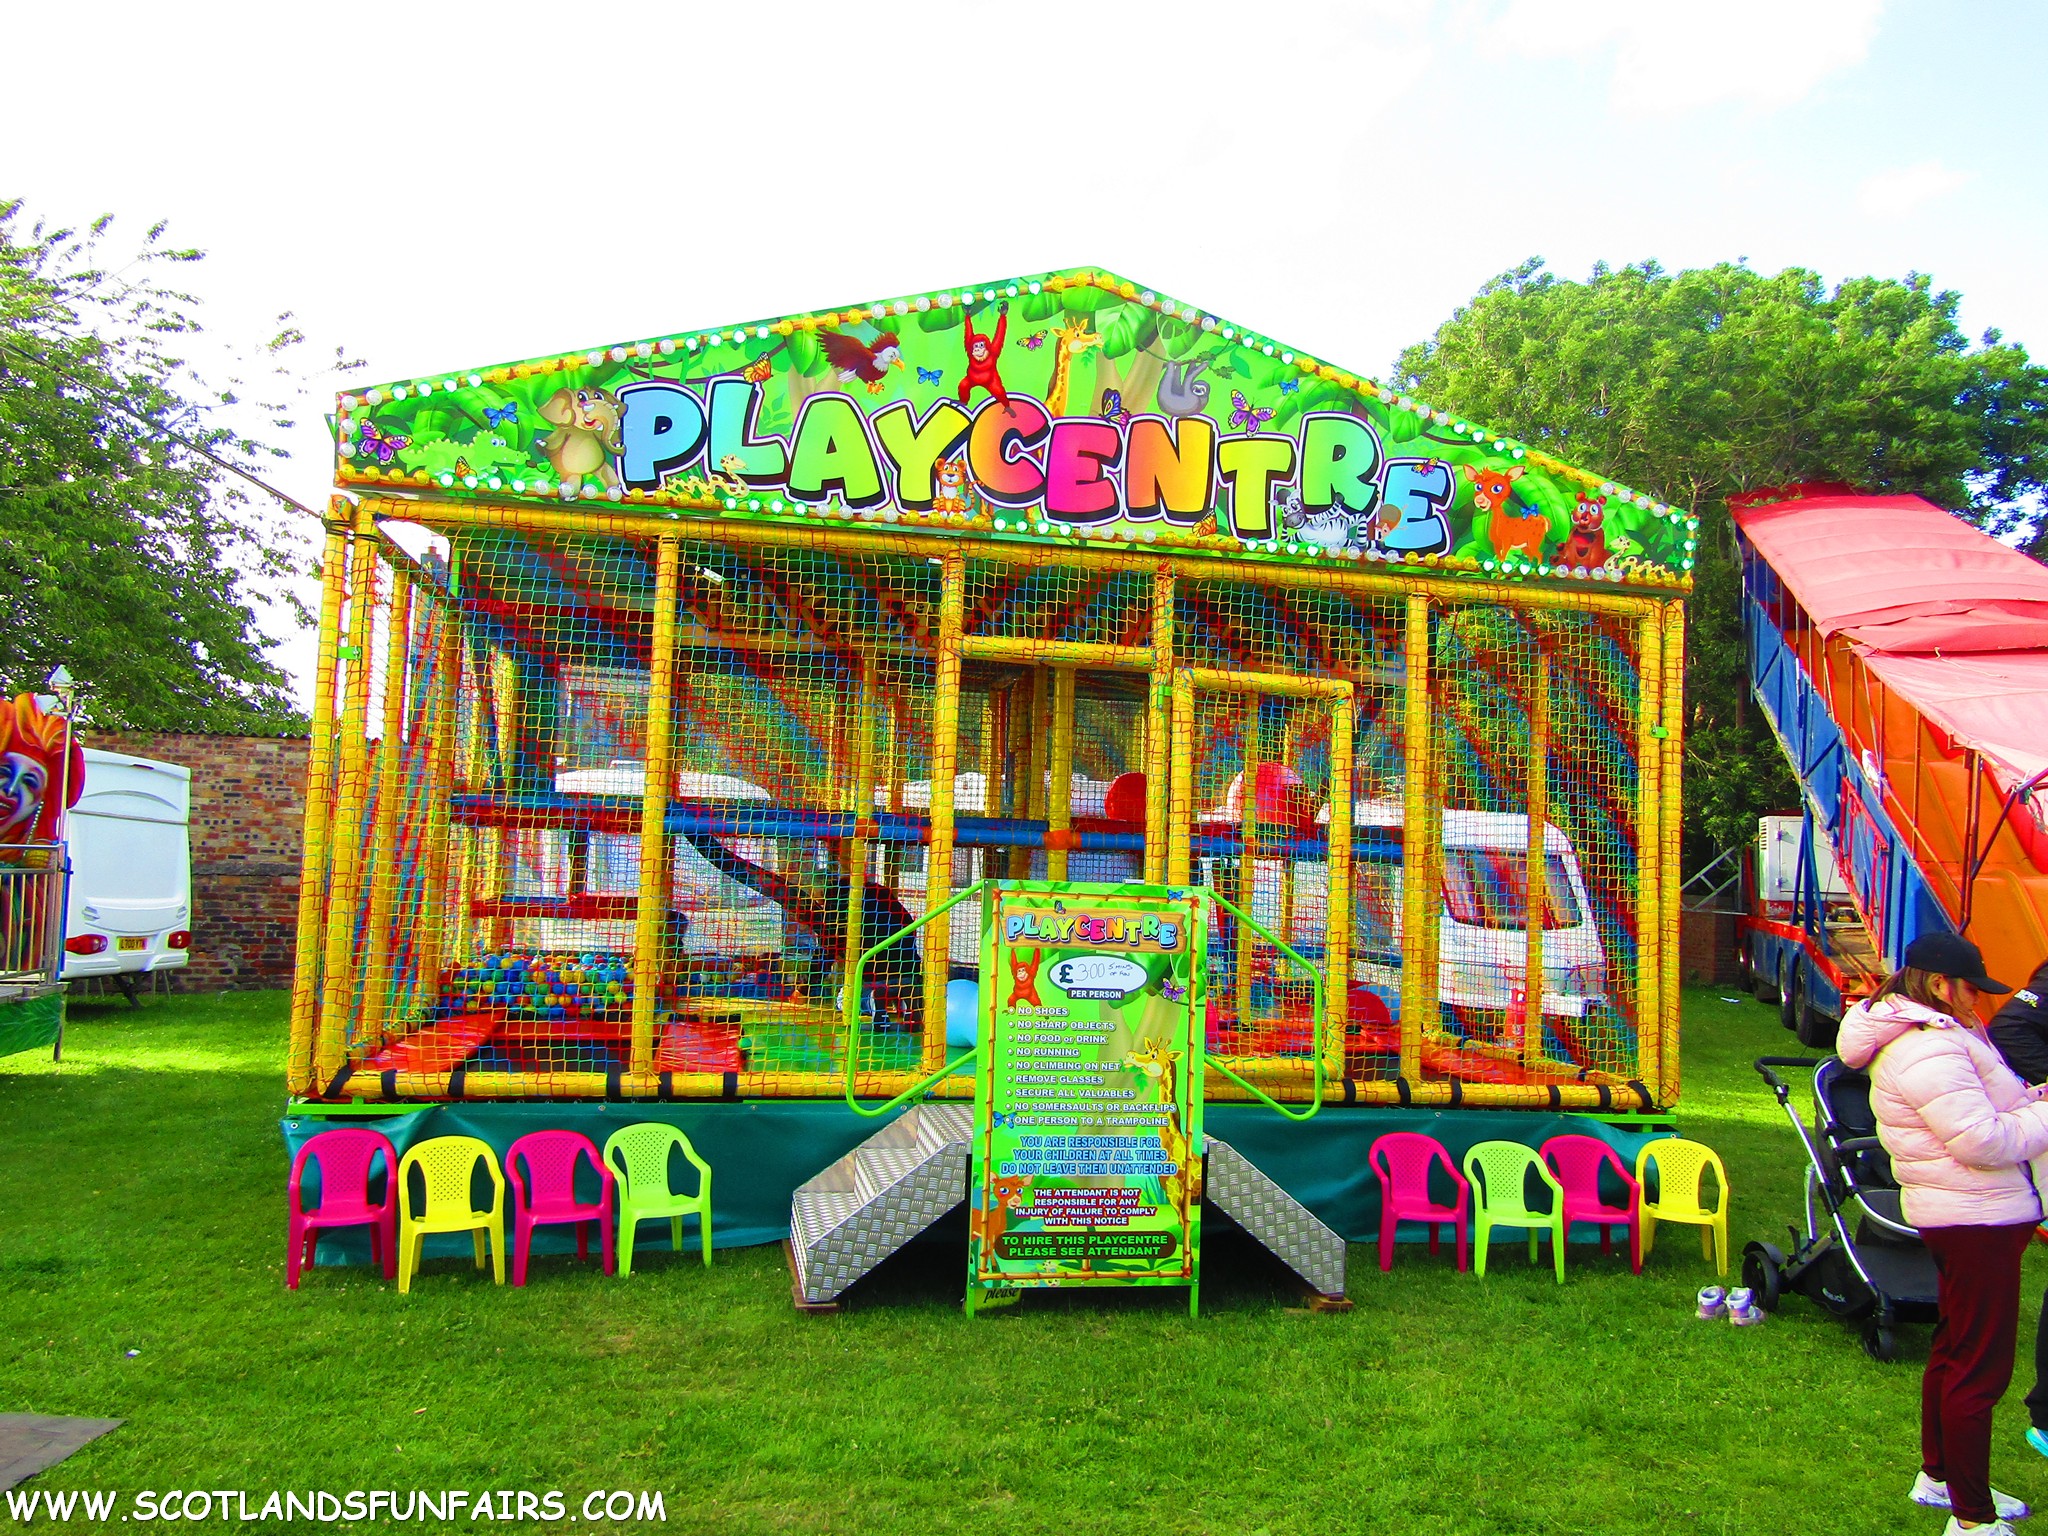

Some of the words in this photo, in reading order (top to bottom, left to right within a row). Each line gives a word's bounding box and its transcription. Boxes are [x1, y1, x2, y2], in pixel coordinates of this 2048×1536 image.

[620, 373, 1453, 558] PLAYCENTRE
[1006, 913, 1178, 948] PLAYCENTRE
[1071, 989, 1087, 998] PER
[1089, 990, 1122, 998] PERSON
[1018, 1007, 1033, 1015] NO
[1035, 1007, 1068, 1016] SHOES
[1017, 1020, 1032, 1029] NO
[1034, 1021, 1067, 1029] SHARP
[1070, 1022, 1116, 1030] OBJECTS
[1017, 1034, 1032, 1042] NO
[1076, 1035, 1107, 1043] DRINK
[1016, 1048, 1031, 1056] NO
[1034, 1048, 1079, 1056] RUNNING
[1033, 1062, 1081, 1070] CLIMBING
[1101, 1063, 1121, 1071] NET
[1016, 1075, 1057, 1083] REMOVE
[1060, 1076, 1103, 1084] GLASSES
[1058, 1089, 1075, 1097] ALL
[1078, 1090, 1135, 1098] VALUABLES
[1032, 1103, 1103, 1111] SOMERSAULTS
[1123, 1104, 1176, 1112] BACKFLIPS
[1014, 1117, 1035, 1125] ONE
[1038, 1117, 1078, 1125] PERSON
[1080, 1117, 1094, 1125] TO
[1096, 1117, 1103, 1125] A
[1020, 1136, 1042, 1147] YOU
[1044, 1136, 1065, 1147] ARE
[1068, 1136, 1137, 1147] RESPONSIBLE
[1140, 1137, 1161, 1148] FOR
[1014, 1150, 1042, 1161] YOUR
[1044, 1150, 1096, 1161] CHILDREN
[1098, 1150, 1112, 1161] AT
[1114, 1150, 1133, 1161] ALL
[1135, 1150, 1167, 1161] TIMES
[1002, 1163, 1017, 1174] DO
[1019, 1163, 1041, 1174] NOT
[1044, 1163, 1076, 1174] LEAVE
[1078, 1163, 1107, 1174] THEM
[1110, 1163, 1177, 1174] UNATTENDED
[1034, 1189, 1052, 1197] THE
[1054, 1189, 1108, 1197] ATTENDANT
[1110, 1189, 1119, 1197] IS
[1121, 1189, 1140, 1197] NOT
[1034, 1198, 1096, 1206] RESPONSIBLE
[1099, 1198, 1116, 1206] FOR
[1118, 1198, 1138, 1206] ANY
[1044, 1217, 1068, 1225] WITH
[1071, 1217, 1092, 1225] THIS
[1002, 1236, 1019, 1245] TO
[1022, 1236, 1053, 1245] HIRE
[1056, 1236, 1086, 1245] THIS
[1089, 1236, 1168, 1244] PLAYCENTRE
[1009, 1248, 1057, 1256] PLEASE
[1060, 1247, 1084, 1256] SEE
[1088, 1246, 1161, 1255] ATTENDANT
[983, 1287, 1017, 1303] please
